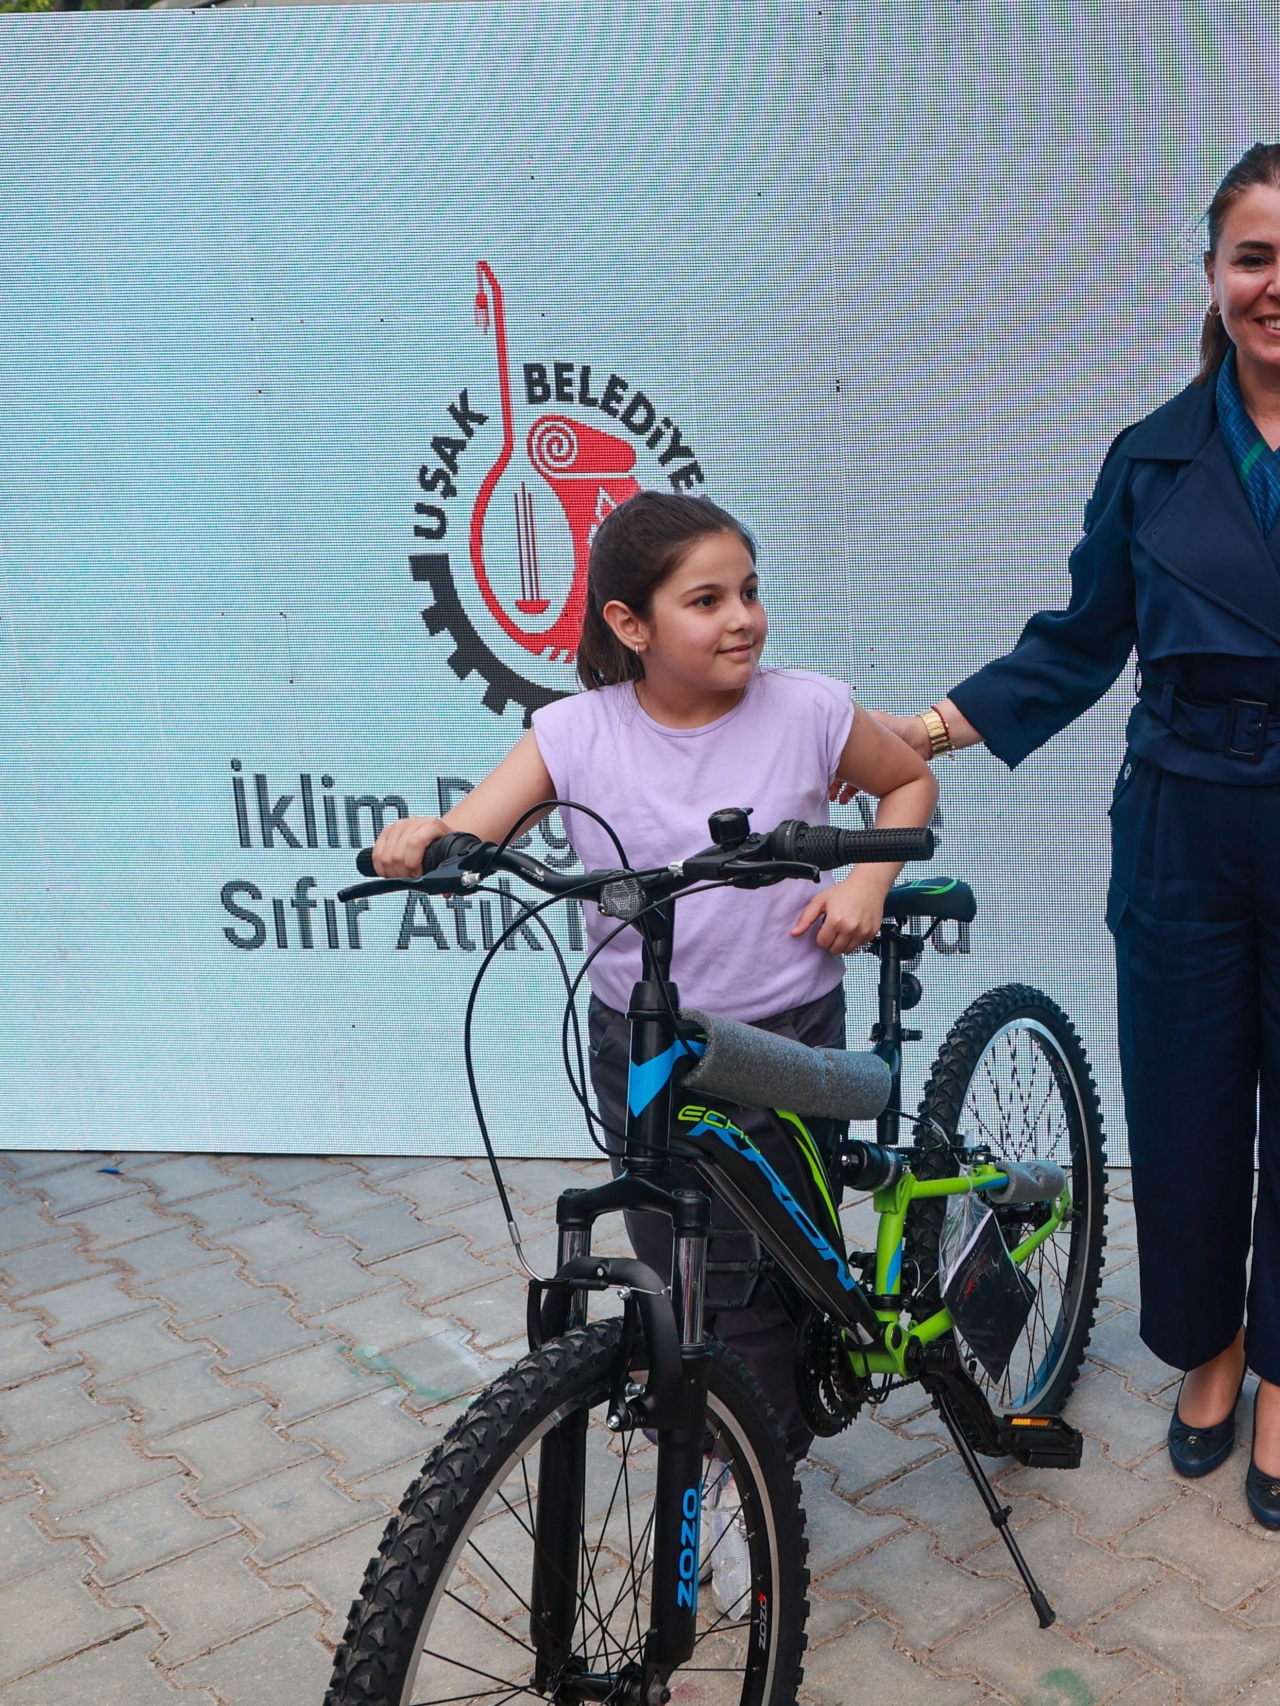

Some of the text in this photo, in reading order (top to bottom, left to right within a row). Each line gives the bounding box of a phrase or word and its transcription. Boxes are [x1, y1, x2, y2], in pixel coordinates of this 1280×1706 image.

[412, 387, 489, 541] UŞAK
[231, 758, 410, 849] İklim
[219, 876, 370, 950] Sıfır
[676, 1487, 698, 1609] ZOZO
